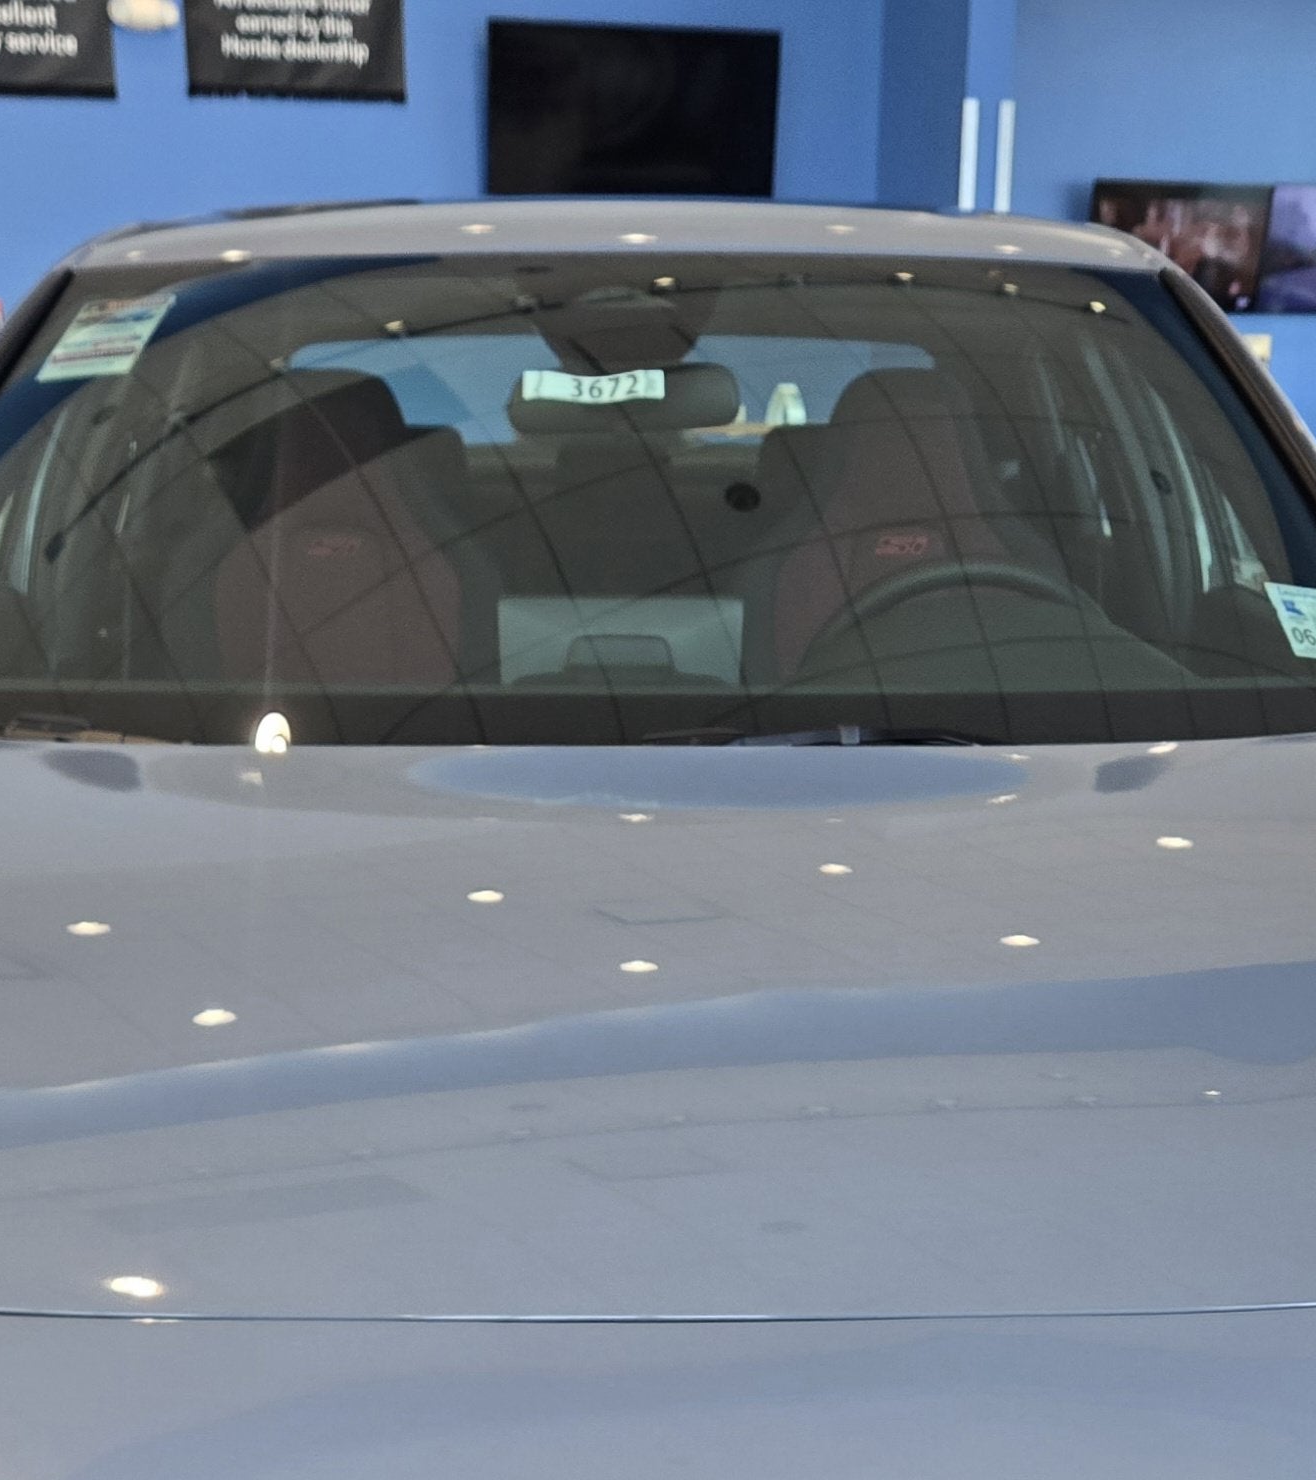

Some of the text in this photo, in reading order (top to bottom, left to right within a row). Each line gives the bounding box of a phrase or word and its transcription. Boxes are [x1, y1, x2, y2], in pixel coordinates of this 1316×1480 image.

[4, 29, 78, 57] service
[220, 33, 282, 61] Honda
[571, 374, 639, 399] 3672
